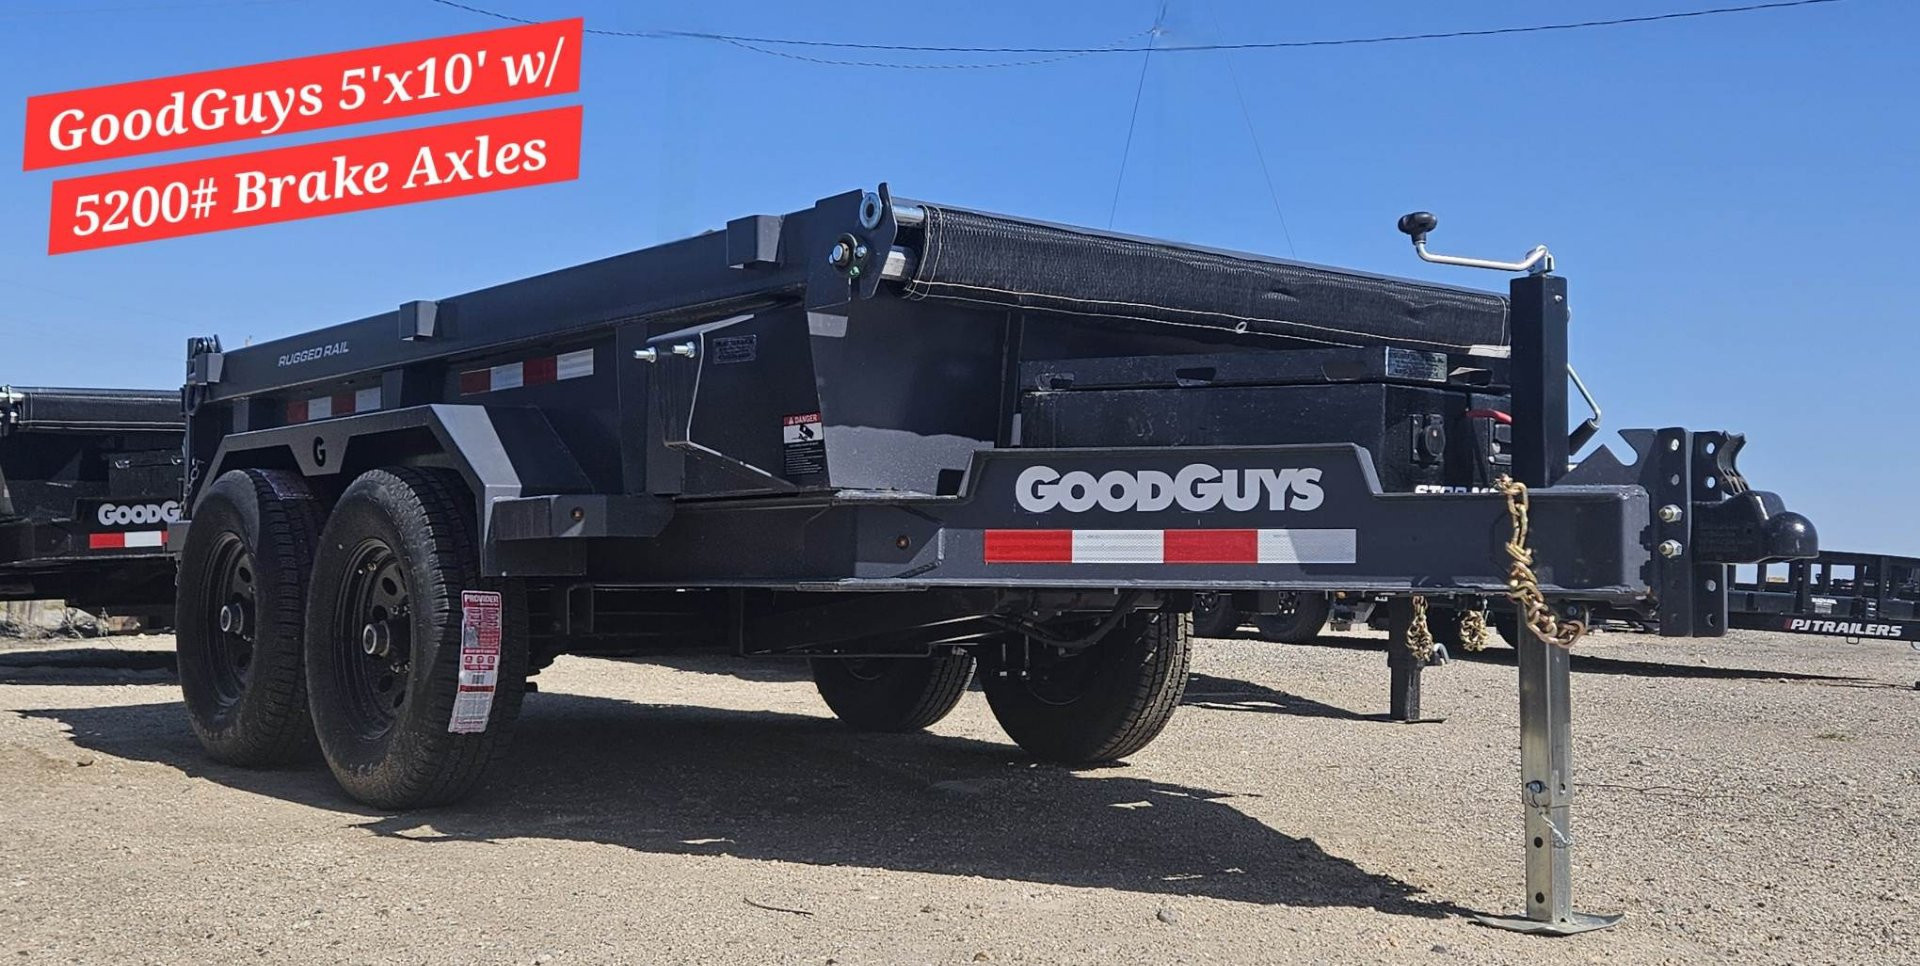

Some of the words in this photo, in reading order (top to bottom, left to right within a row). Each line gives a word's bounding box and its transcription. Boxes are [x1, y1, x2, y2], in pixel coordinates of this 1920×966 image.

[277, 347, 323, 367] RUGGED
[323, 341, 349, 357] RAIL
[794, 414, 818, 425] DANGER
[464, 594, 499, 603] PROVIDER
[1812, 622, 1903, 637] TRAILERS
